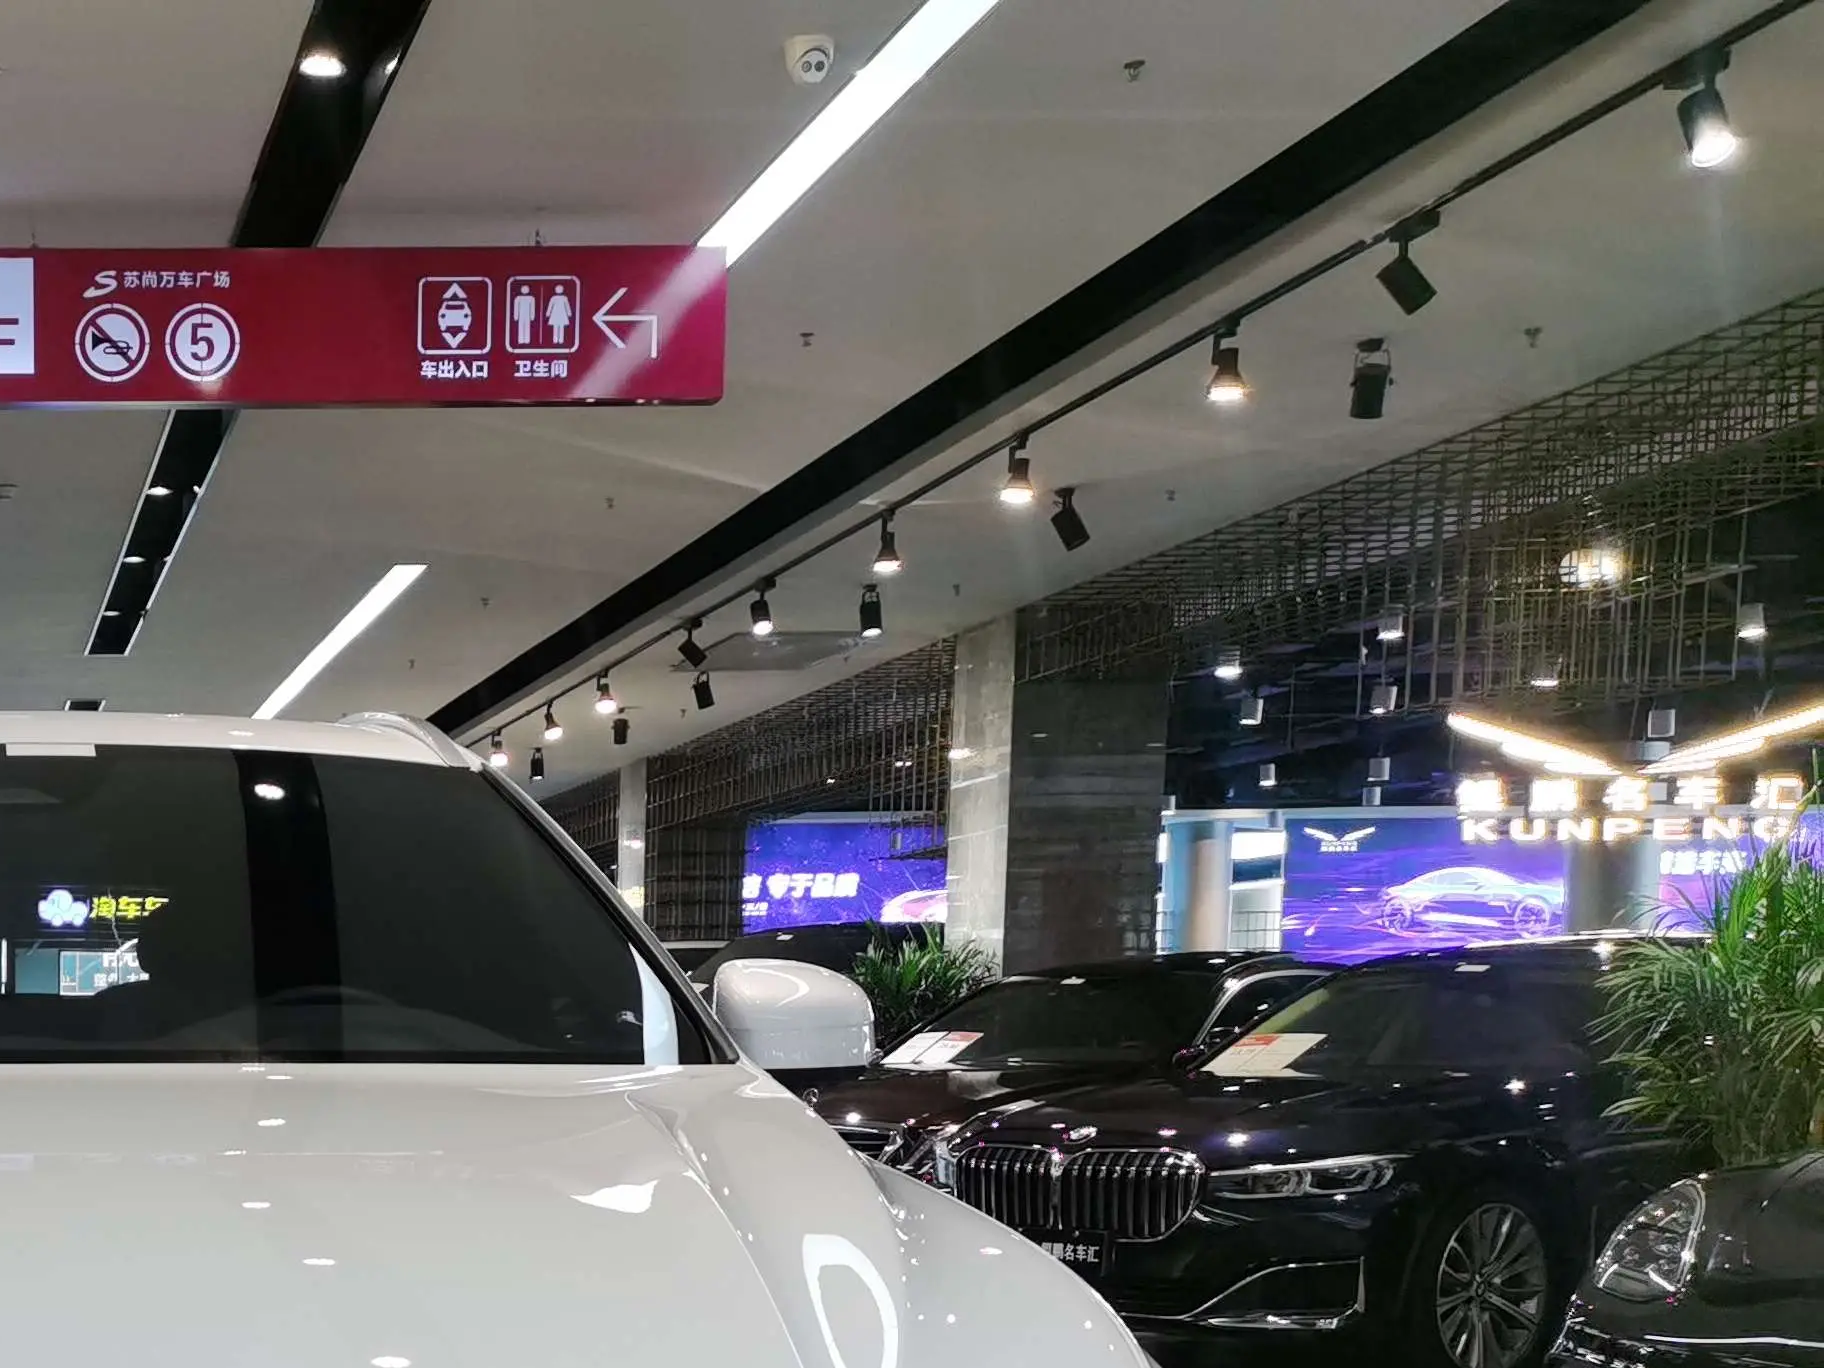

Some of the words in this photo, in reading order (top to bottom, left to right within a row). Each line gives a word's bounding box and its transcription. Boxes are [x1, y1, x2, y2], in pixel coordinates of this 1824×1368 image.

[123, 271, 231, 289] 苏尚万车广场
[190, 322, 215, 361] 5
[420, 360, 488, 378] 车出入口
[514, 360, 568, 378] 卫生间
[1460, 817, 1794, 842] KUNPENG
